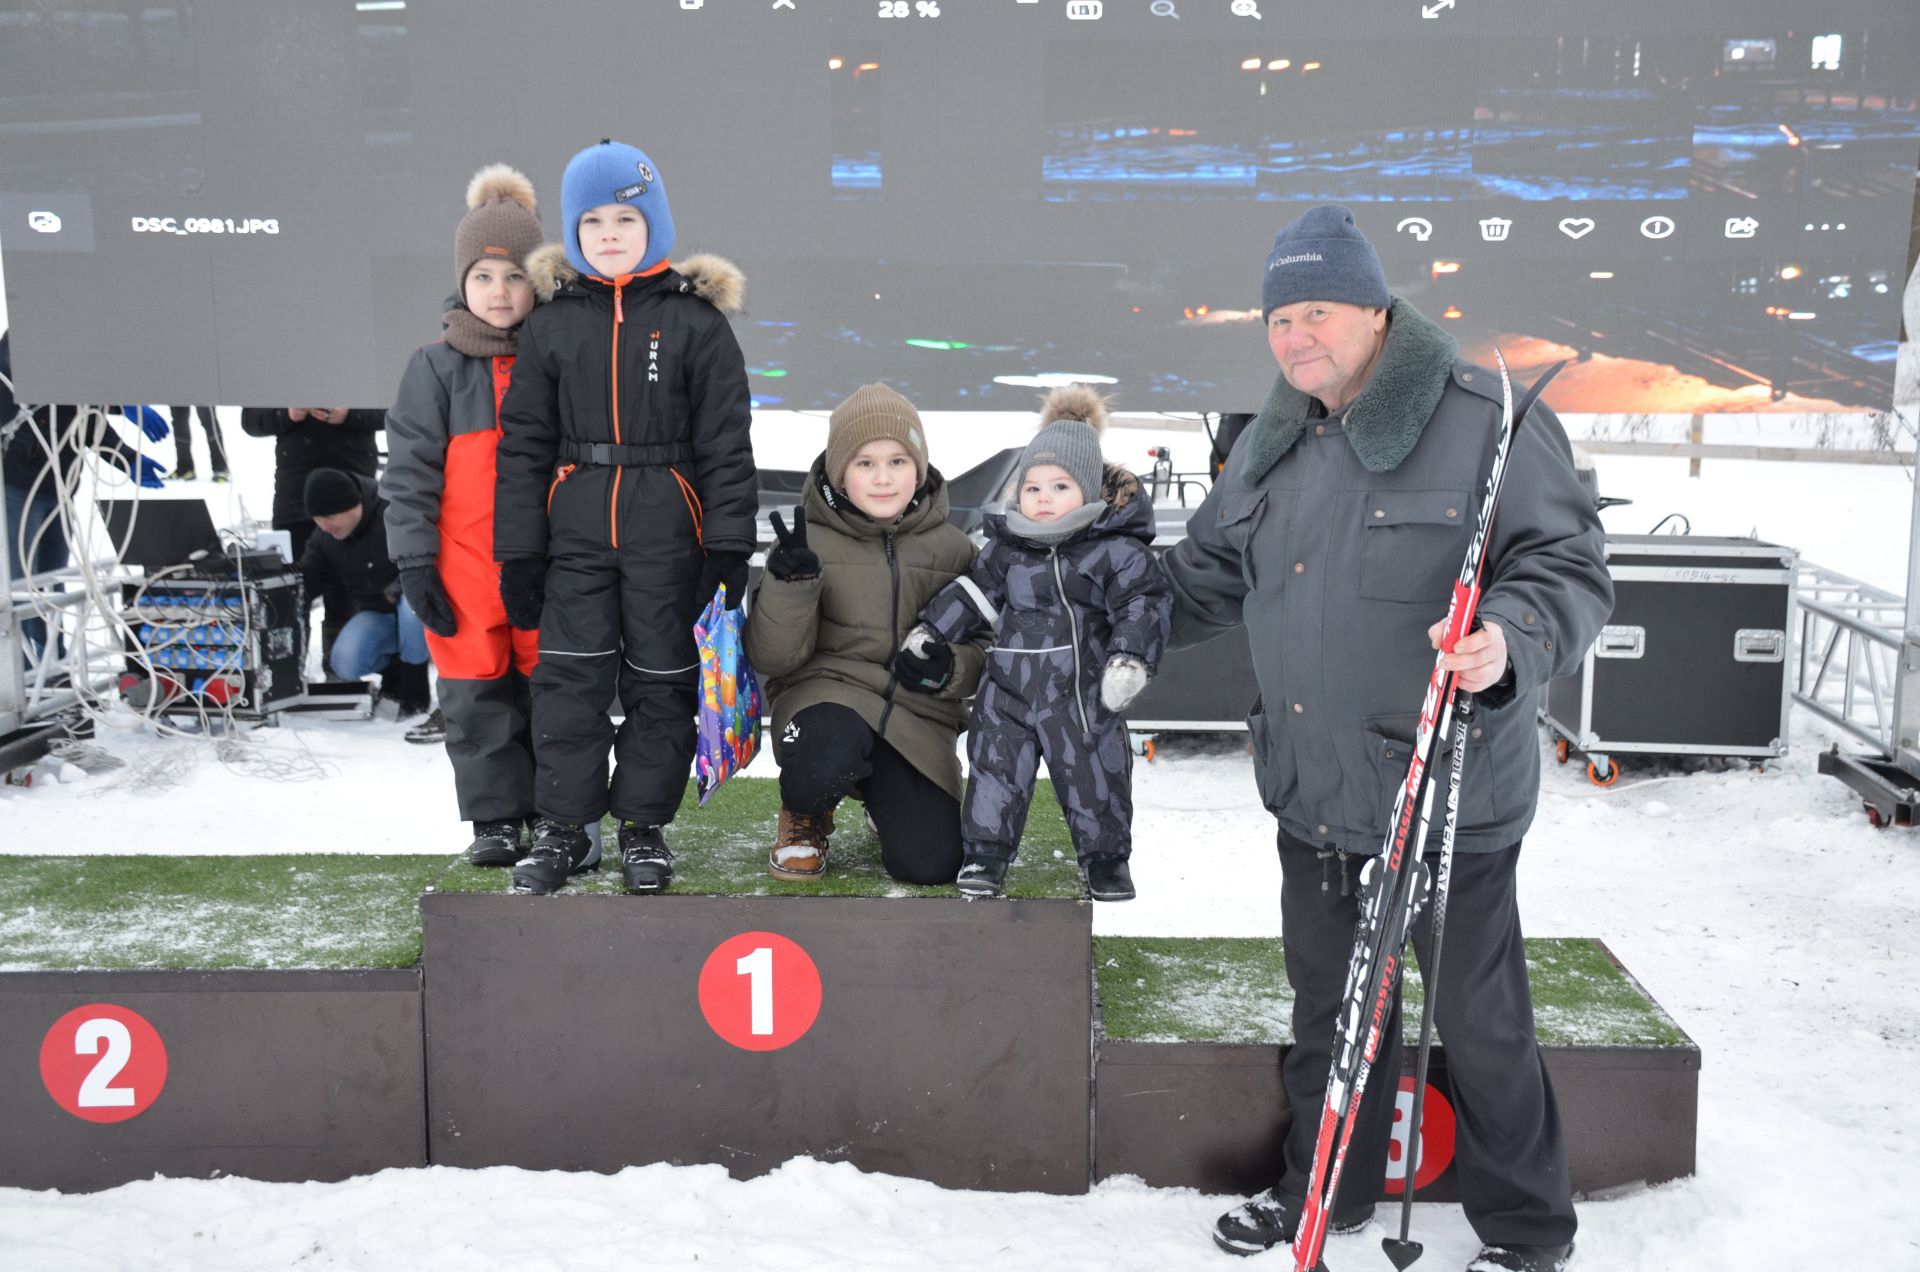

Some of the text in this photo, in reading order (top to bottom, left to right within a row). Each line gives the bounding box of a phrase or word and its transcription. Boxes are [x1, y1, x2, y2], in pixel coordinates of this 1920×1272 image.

[878, 1, 941, 18] 28 %
[1275, 252, 1323, 267] Columbia
[1390, 796, 1414, 871] CLASSIC
[1437, 766, 1463, 893] UNIVERSAL
[737, 947, 773, 1035] 1
[1372, 954, 1396, 1027] CLASSIC
[75, 1018, 135, 1107] 2
